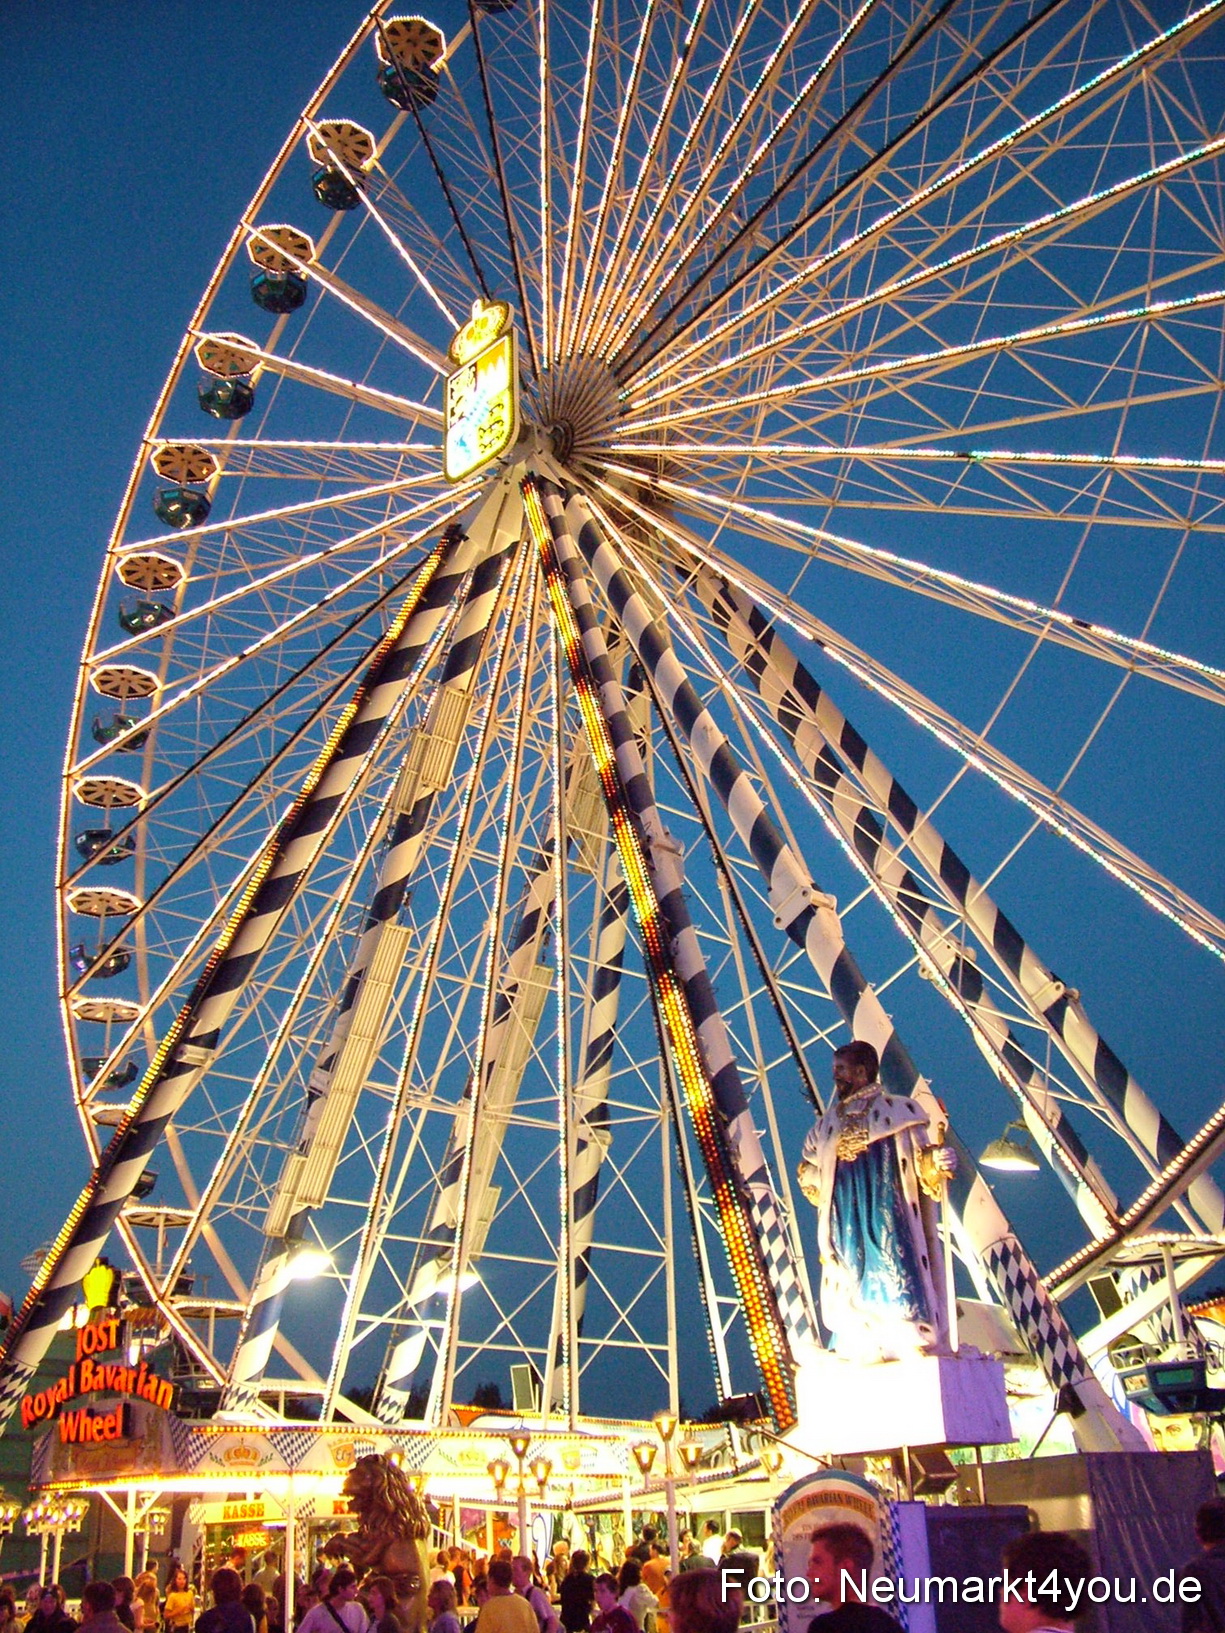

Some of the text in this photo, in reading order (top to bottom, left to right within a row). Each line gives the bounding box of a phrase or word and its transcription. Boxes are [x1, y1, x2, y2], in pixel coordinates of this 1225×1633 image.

[76, 1319, 119, 1362] JOST
[21, 1360, 173, 1428] Royal Bavarian
[59, 1404, 123, 1443] Wheel
[223, 1503, 264, 1520] KASSE
